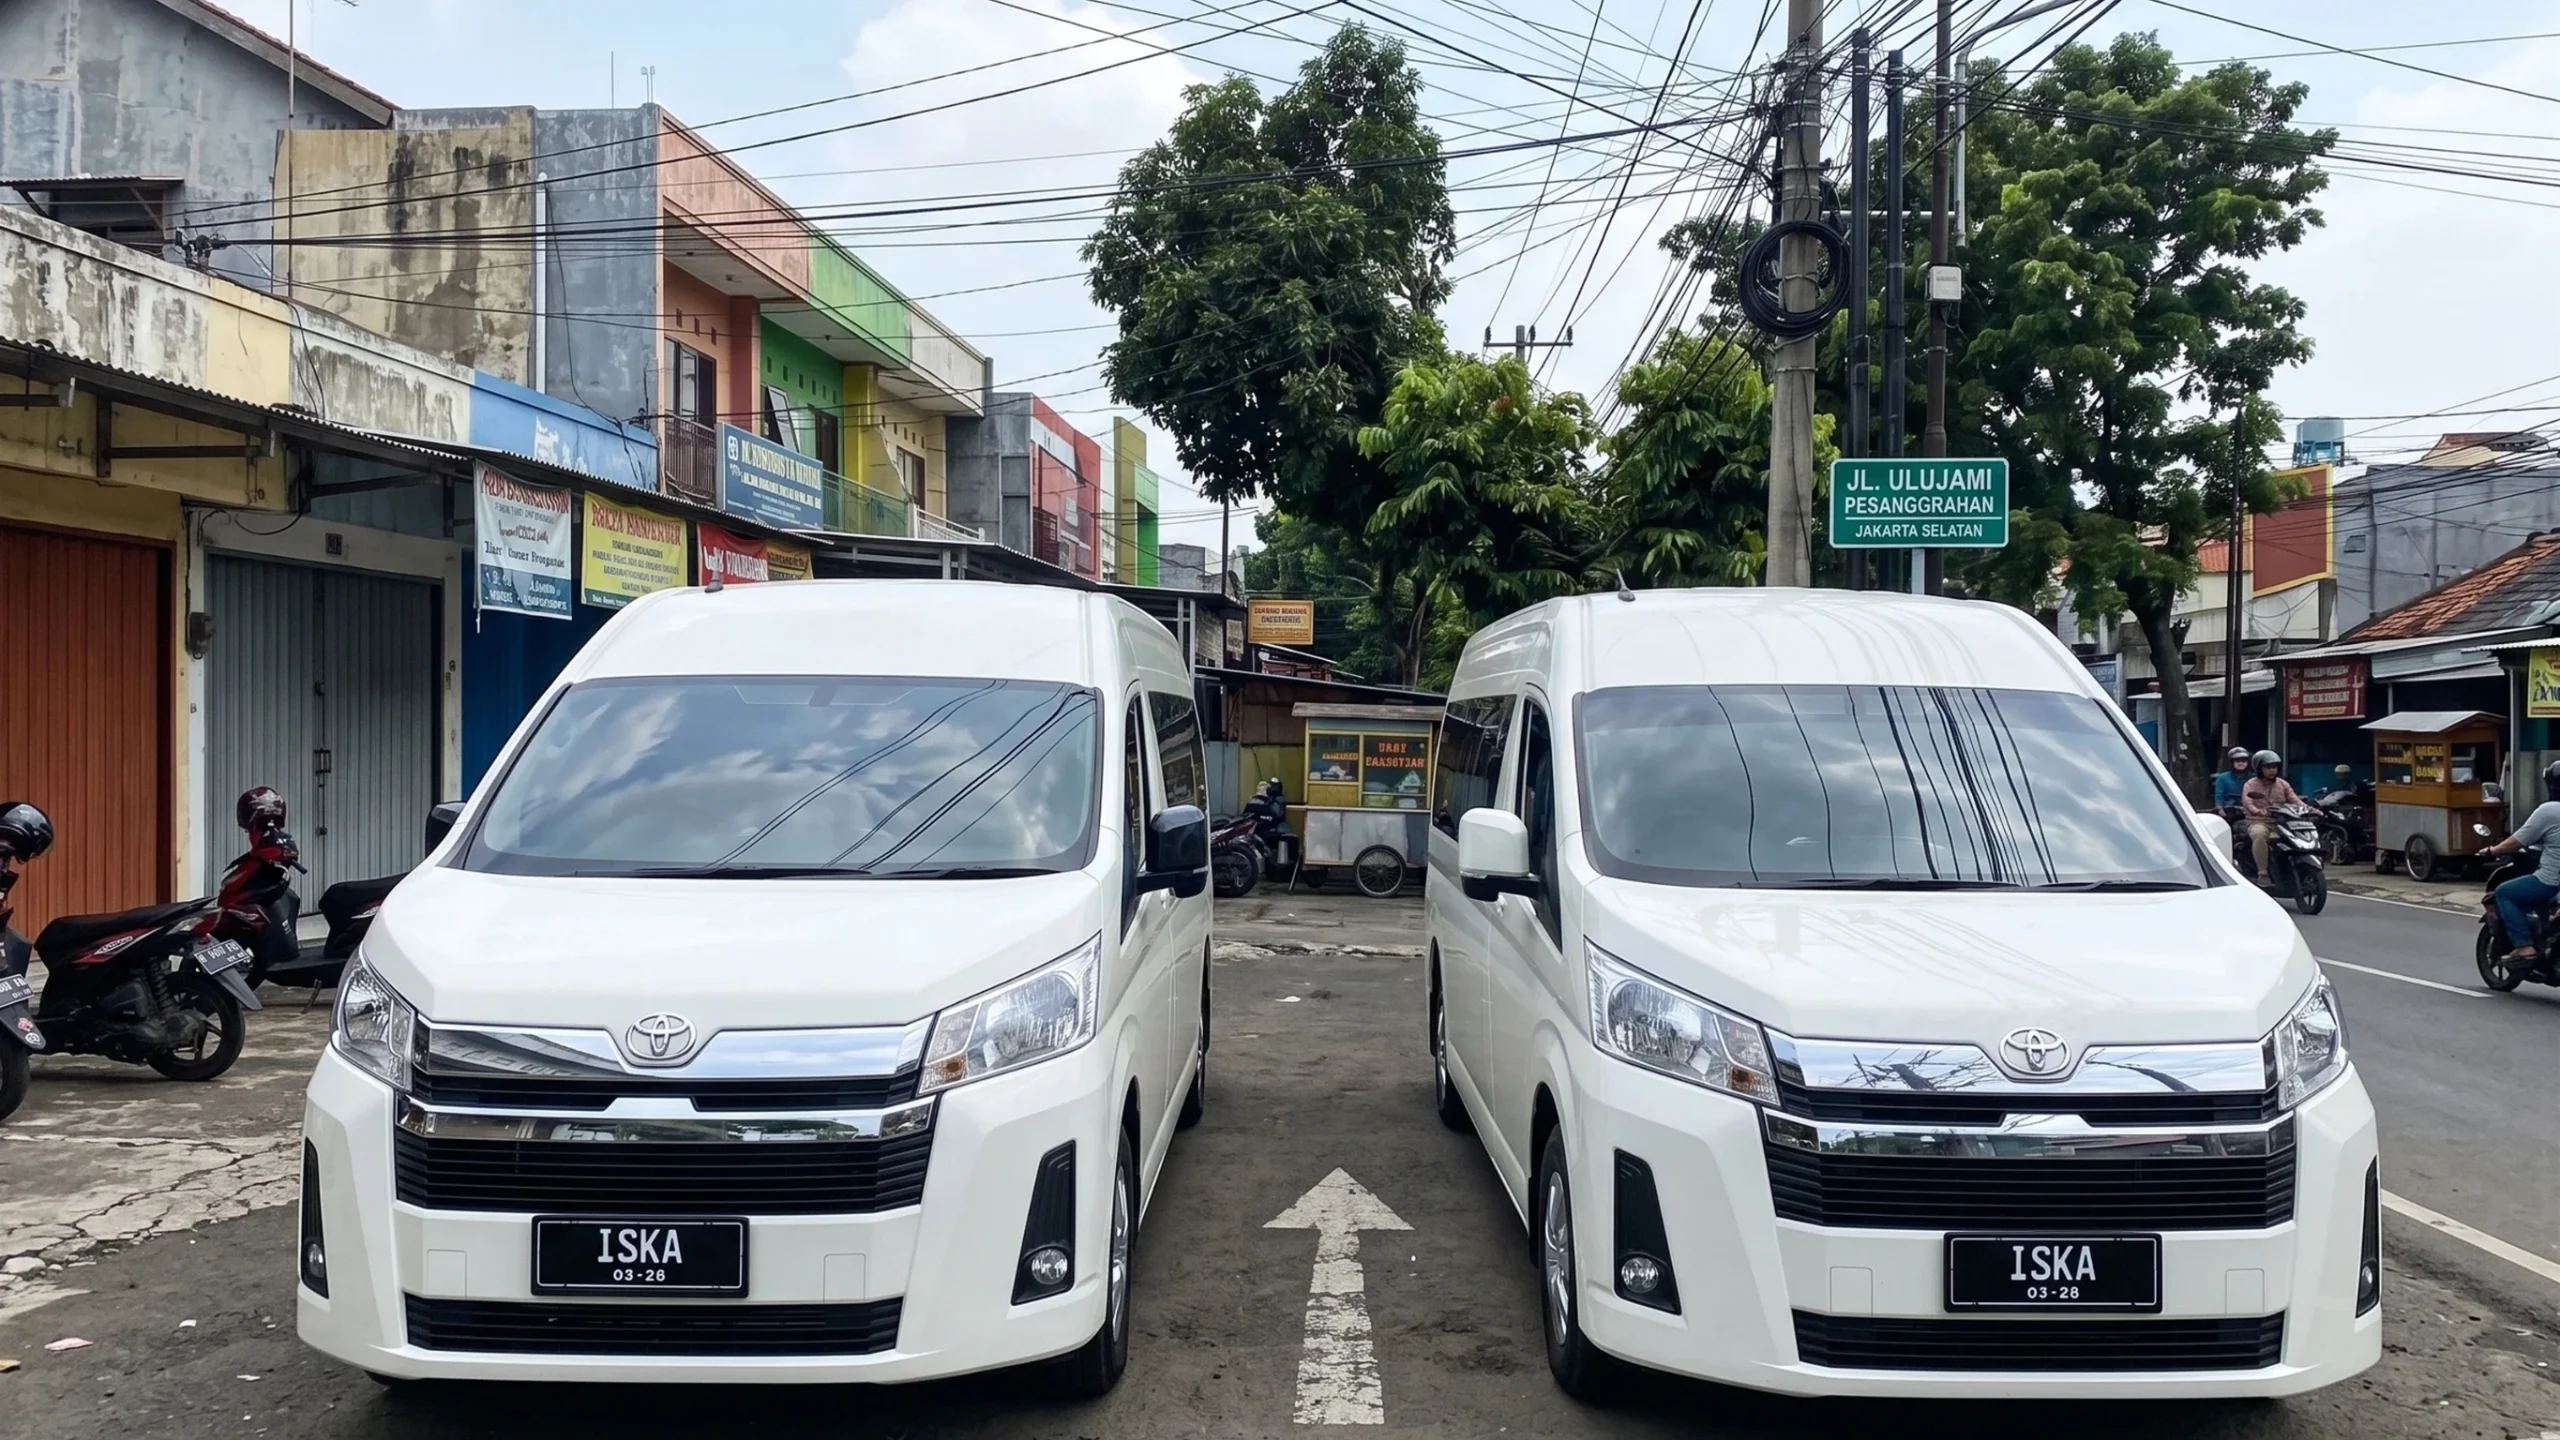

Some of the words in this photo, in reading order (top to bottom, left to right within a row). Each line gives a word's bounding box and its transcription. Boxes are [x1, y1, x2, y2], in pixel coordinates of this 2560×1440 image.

[1846, 469, 1880, 491] JL.
[1889, 468, 1992, 491] ULUJAMI
[1845, 496, 1994, 514] PESANGGRAHAN
[1855, 524, 1918, 538] JAKARTA
[1922, 523, 1983, 538] SELATAN
[597, 1228, 683, 1264] ISKA
[2010, 1245, 2097, 1281] ISKA
[613, 1268, 666, 1282] 03-26
[2027, 1286, 2080, 1299] 03-28
